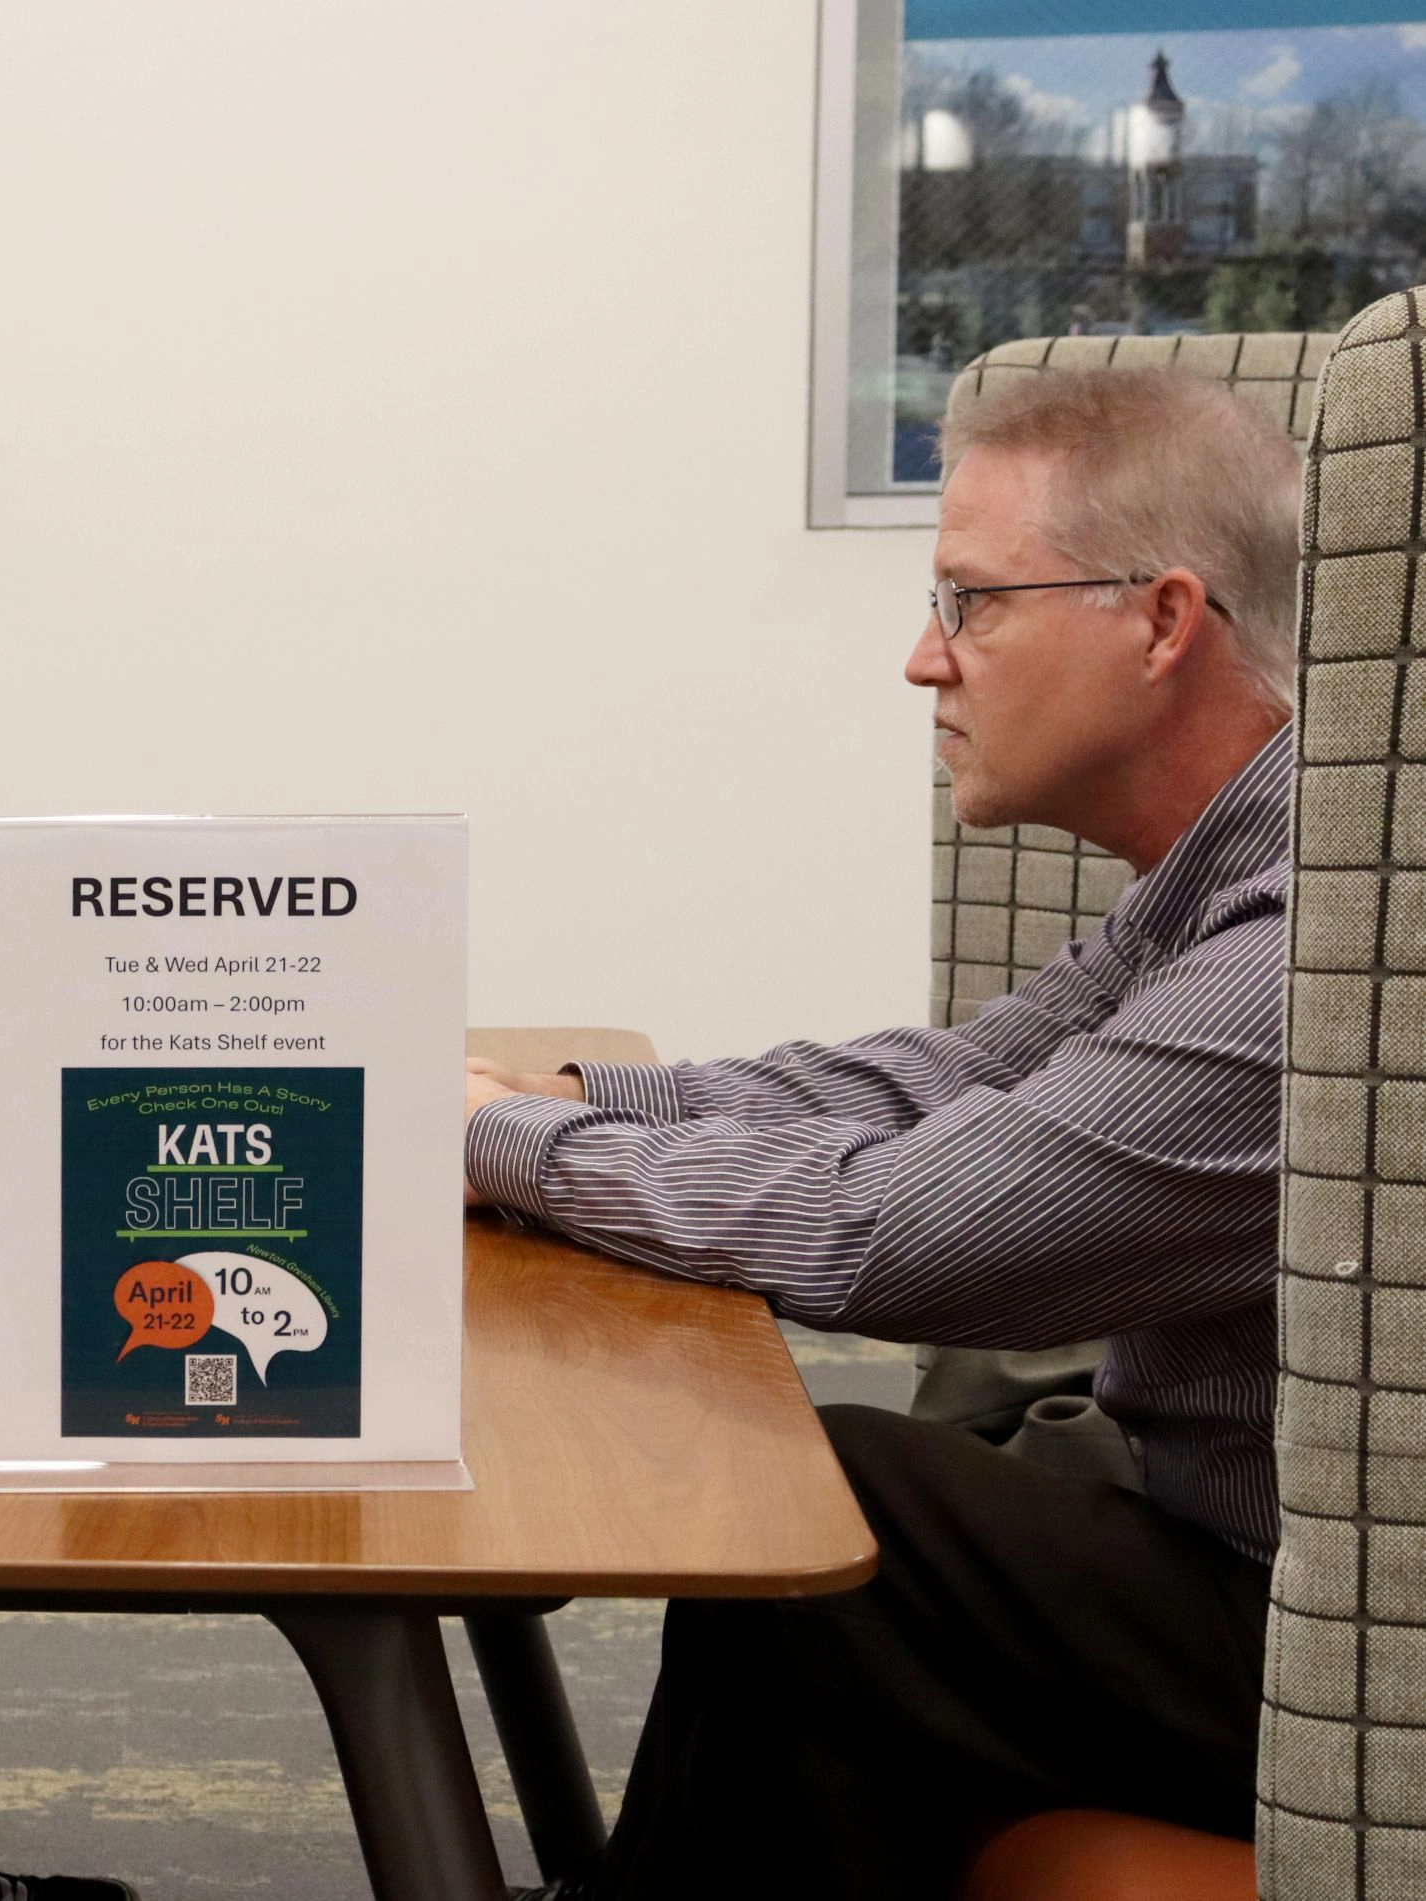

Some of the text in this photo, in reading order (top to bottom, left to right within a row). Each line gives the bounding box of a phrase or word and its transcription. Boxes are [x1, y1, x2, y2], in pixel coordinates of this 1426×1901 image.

[73, 877, 357, 916] RESERVED
[105, 956, 321, 976] Tue & Wed April 21-22
[122, 996, 208, 1012] 10:00am
[230, 995, 305, 1015] 2:00pm
[100, 1034, 325, 1050] for the Kats Shelf event
[87, 1082, 332, 1112] Every Person Has A Story
[138, 1097, 284, 1115] Check One Out!
[158, 1123, 272, 1165] KATS
[126, 1177, 303, 1231] SHELF
[128, 1281, 191, 1308] April
[214, 1267, 271, 1296] 10 AM
[144, 1313, 194, 1329] 21-22
[241, 1308, 309, 1337] to 2 PM
